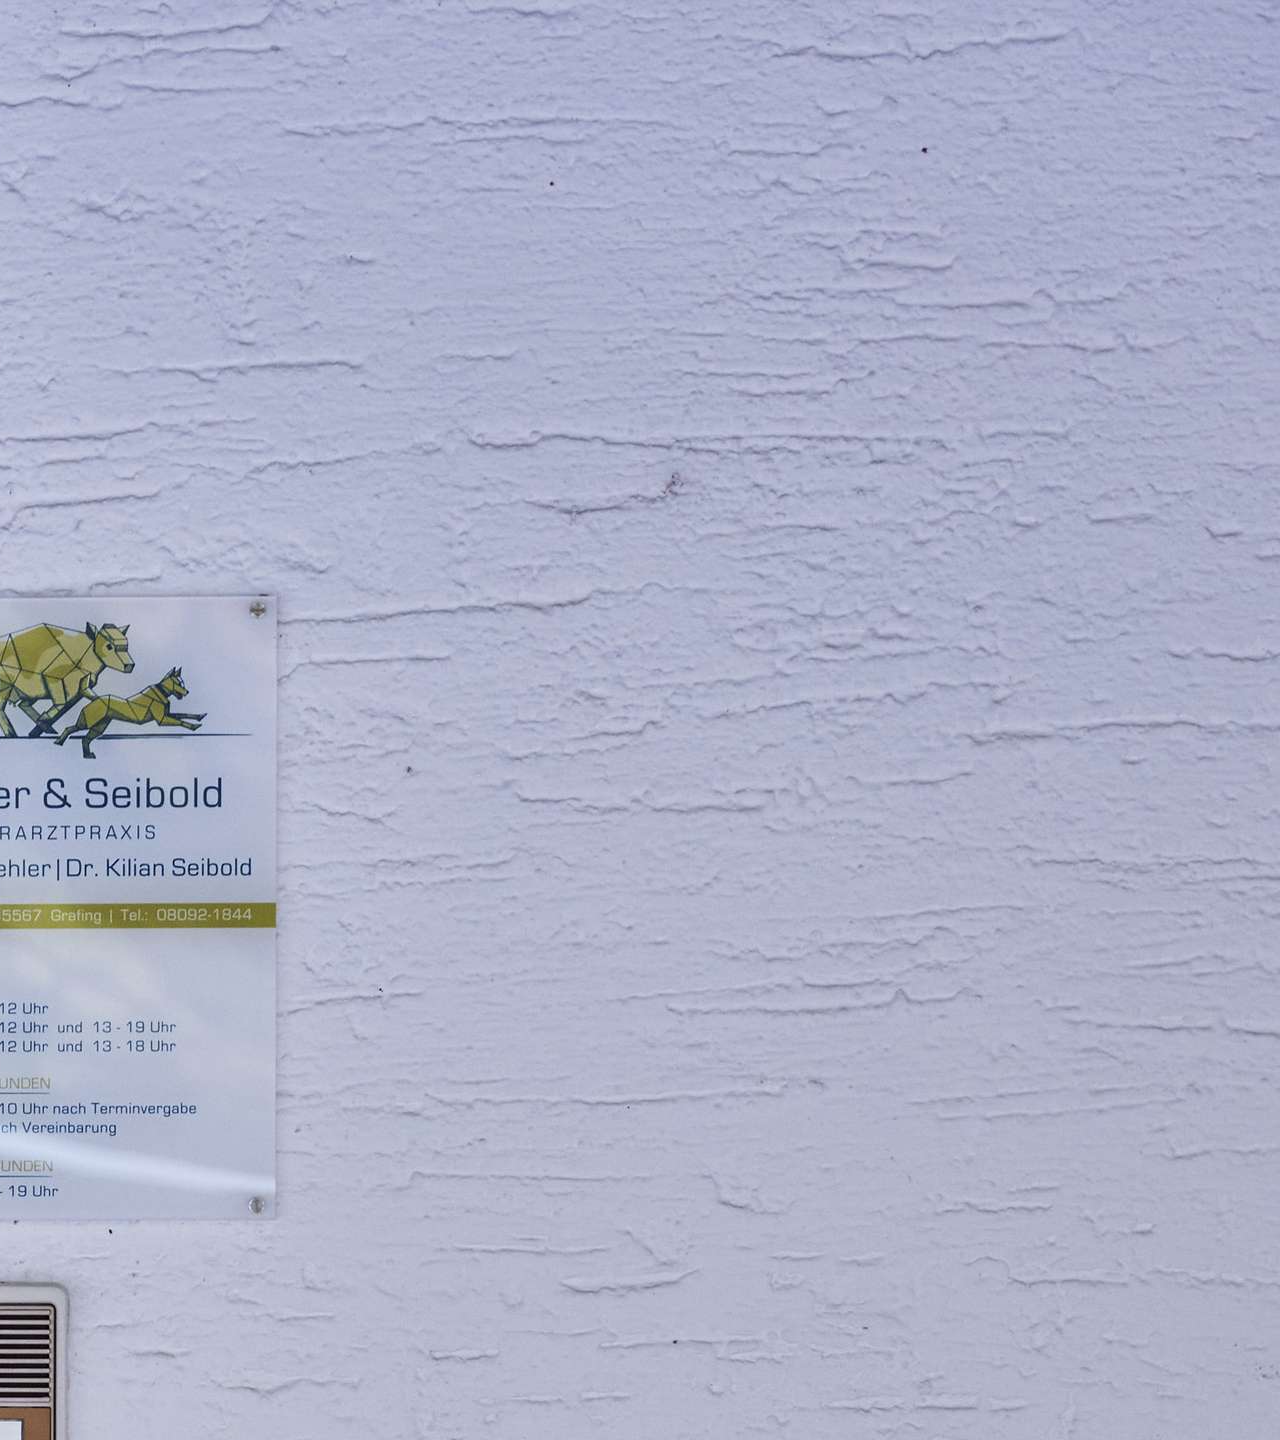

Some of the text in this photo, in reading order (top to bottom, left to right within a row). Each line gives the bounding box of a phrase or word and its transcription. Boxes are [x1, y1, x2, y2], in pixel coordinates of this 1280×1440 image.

[43, 778, 72, 809] &
[85, 777, 222, 809] Seibold
[66, 859, 98, 878] Dr.
[106, 859, 165, 877] Kilian
[171, 858, 252, 877] Seibold
[50, 908, 102, 925] Grafing
[120, 909, 148, 922] Tel.:
[156, 908, 252, 921] 08092-1844
[0, 1003, 17, 1015] 12
[22, 1003, 49, 1015] Uhr
[0, 1022, 17, 1034] 12
[22, 1022, 49, 1034] Uhr
[57, 1022, 83, 1034] und
[93, 1022, 112, 1034] 13
[127, 1021, 145, 1034] 19
[150, 1021, 177, 1033] Uhr
[0, 1041, 17, 1053] 12
[22, 1041, 49, 1053] Uhr
[57, 1041, 83, 1053] und
[93, 1040, 112, 1053] 13
[127, 1040, 145, 1053] 18
[150, 1040, 177, 1052] Uhr
[0, 1103, 18, 1115] 10
[22, 1103, 49, 1115] Uhr
[52, 1102, 86, 1115] nach
[91, 1102, 197, 1118] Terminvergabe
[22, 1121, 117, 1137] Vereinbarung
[8, 1185, 27, 1197] 19
[32, 1185, 59, 1197] Uhr
